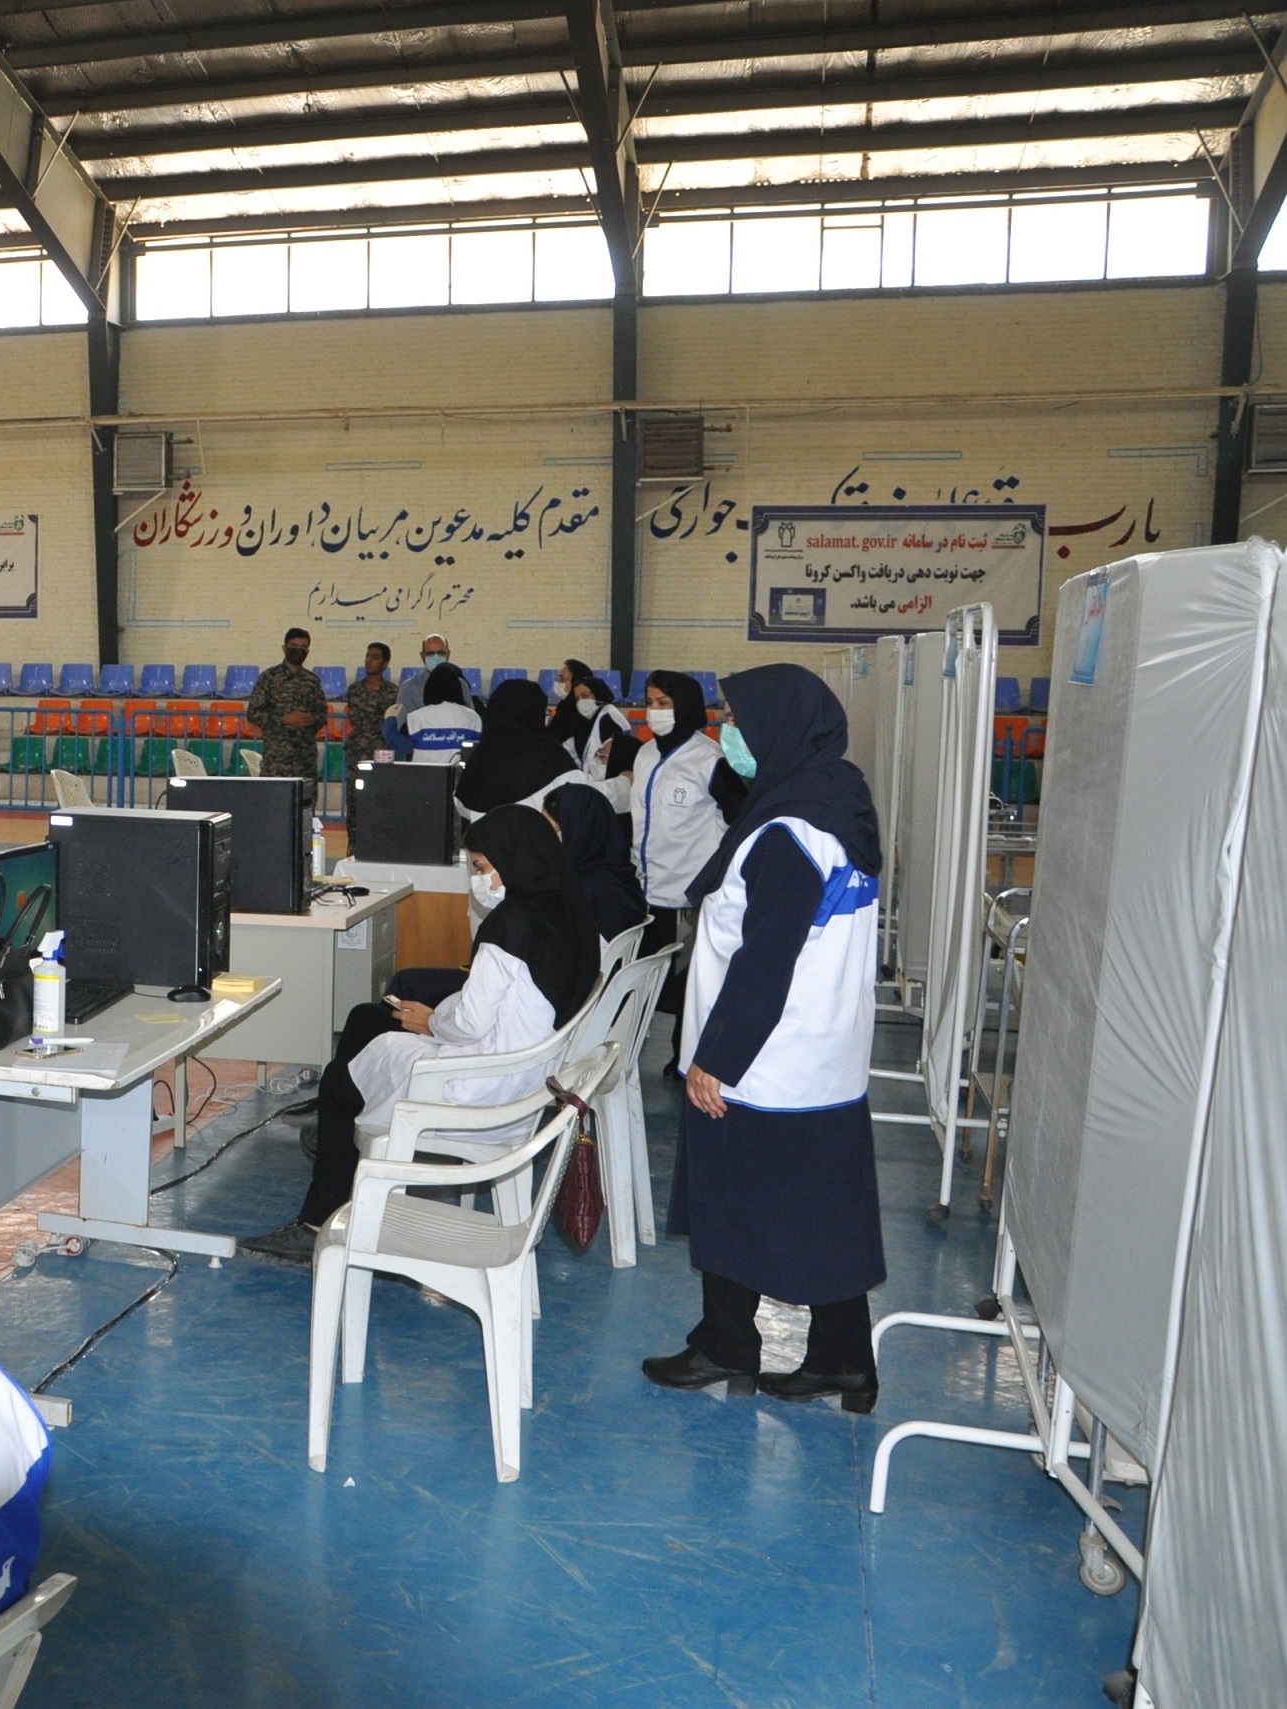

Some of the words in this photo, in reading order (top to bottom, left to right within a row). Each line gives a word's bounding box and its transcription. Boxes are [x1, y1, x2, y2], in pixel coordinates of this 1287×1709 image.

[133, 479, 234, 548] ورزشکاران
[485, 485, 544, 560] کلیه
[539, 487, 600, 550] مقدم
[902, 533, 933, 549] سامانه
[934, 536, 949, 553] در
[950, 533, 966, 553] نام
[967, 532, 988, 553] ثبت
[805, 562, 832, 583] کرونا
[833, 563, 867, 583] واکسن
[868, 562, 905, 584] دریافت
[906, 567, 932, 583] دهی
[933, 564, 959, 584] نوبت
[960, 567, 986, 583] جهت
[385, 571, 435, 613] گرامی
[426, 587, 434, 610] را
[438, 583, 475, 621] محترم
[879, 600, 896, 614] می
[897, 594, 933, 614] الزامی
[422, 732, 446, 742] سلامت
[445, 731, 465, 744] مراقب
